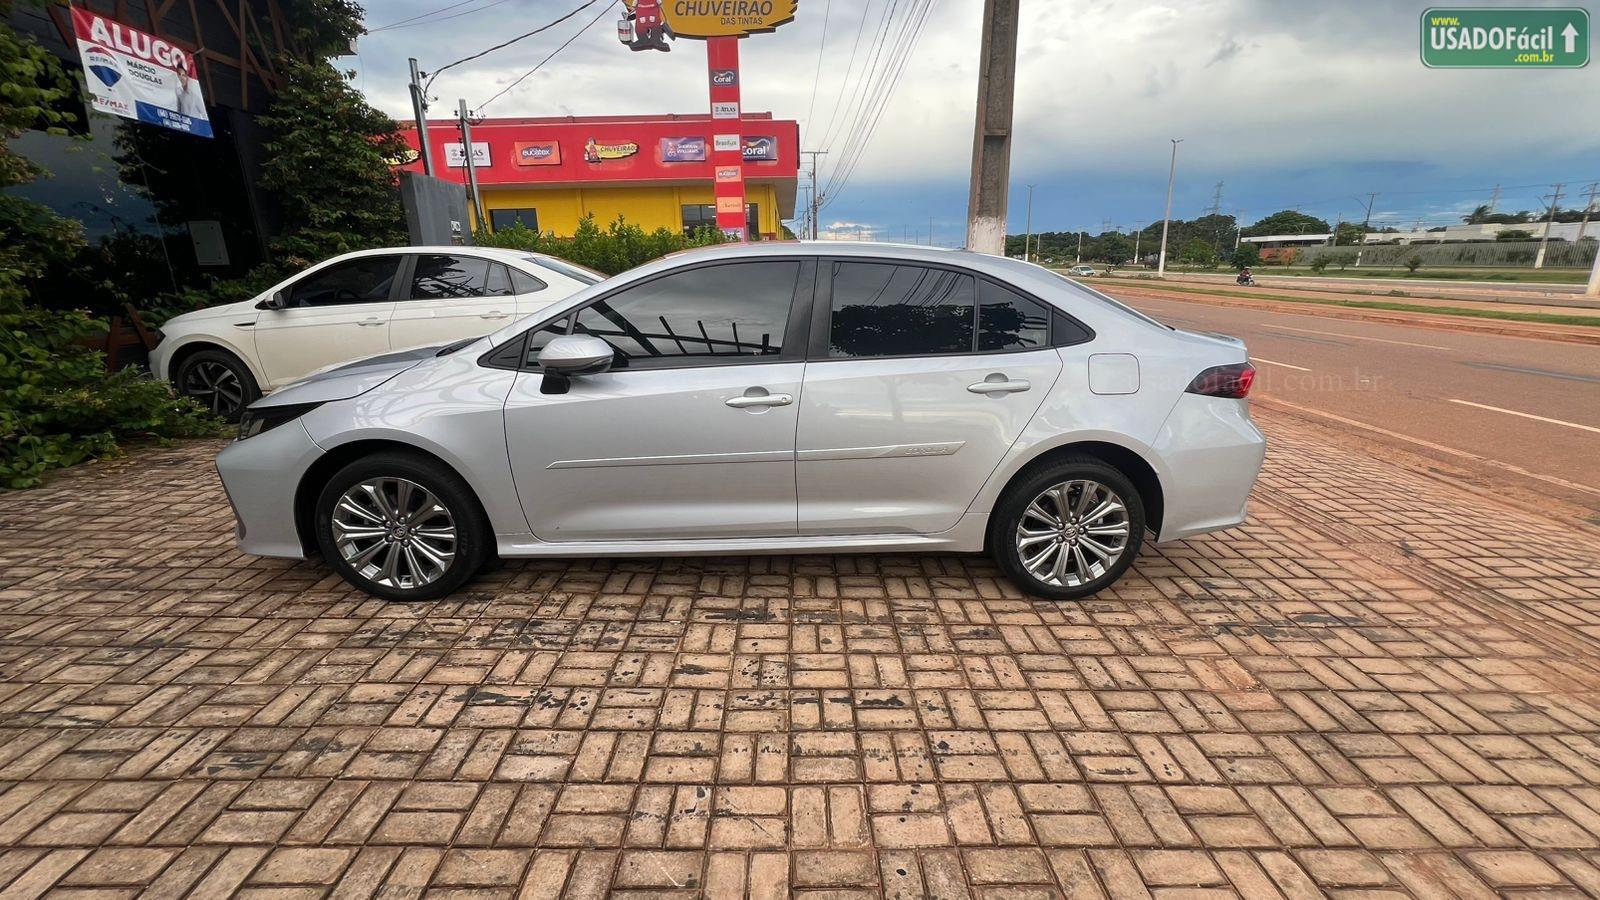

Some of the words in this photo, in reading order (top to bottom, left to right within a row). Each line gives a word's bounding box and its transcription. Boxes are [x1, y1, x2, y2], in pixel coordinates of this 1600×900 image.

[721, 17, 736, 26] DAS
[737, 17, 763, 26] TINTAS
[90, 16, 188, 70] ALUGO
[126, 60, 156, 75] MÁRCIO
[128, 69, 163, 85] DOUGLAS
[713, 75, 731, 83] Coral
[522, 148, 550, 157] eucatex
